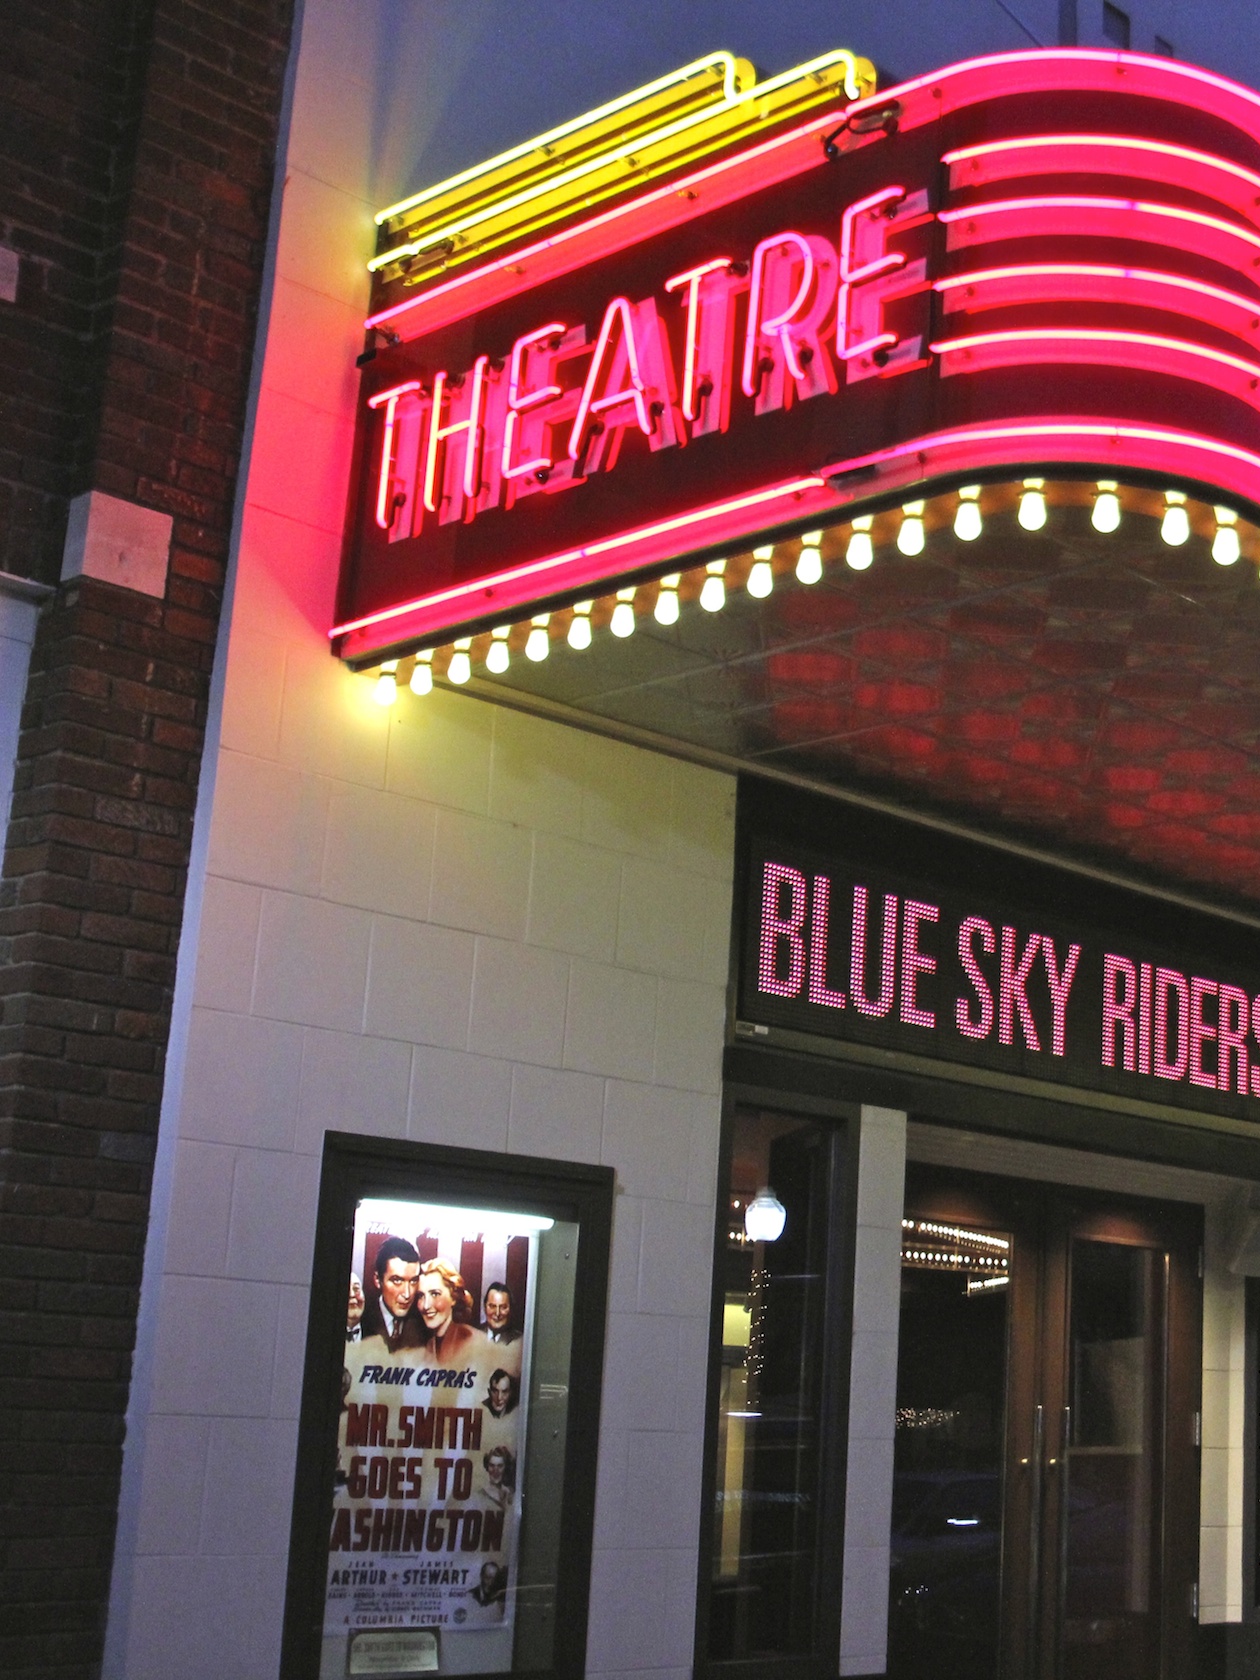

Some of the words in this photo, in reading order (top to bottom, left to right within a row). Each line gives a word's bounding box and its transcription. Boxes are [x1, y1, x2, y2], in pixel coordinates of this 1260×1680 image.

[368, 186, 932, 543] THEATRE
[757, 861, 939, 1029] BLUE
[955, 916, 1082, 1057] SKY
[359, 1365, 415, 1386] FRANK
[416, 1368, 477, 1389] CAPRA'S
[347, 1455, 422, 1500] GOES
[435, 1457, 473, 1501] TO
[329, 1507, 506, 1552] ASHINGTON
[331, 1569, 387, 1586] ARTHUR
[402, 1569, 469, 1586] STEWART
[355, 1615, 404, 1625] COLUMBIA
[410, 1614, 449, 1625] PICTURE
